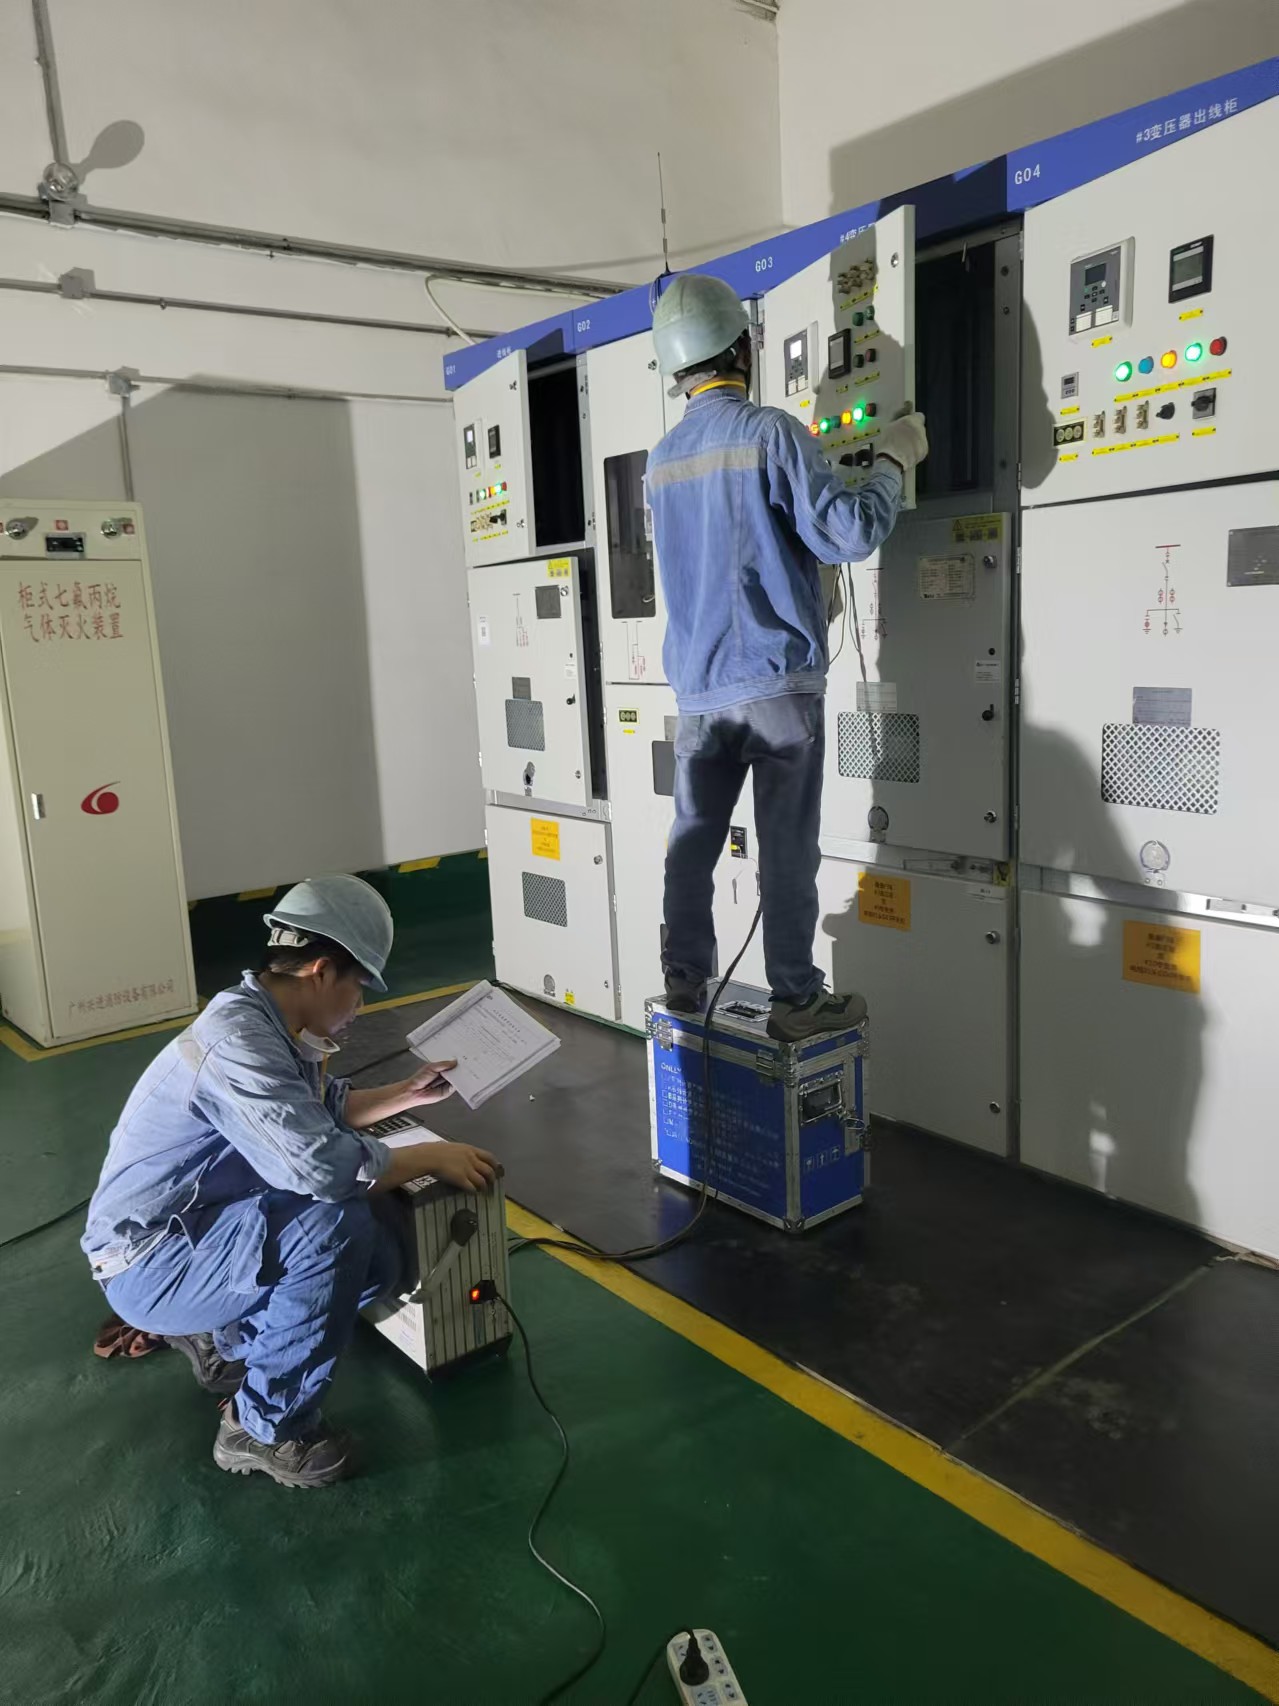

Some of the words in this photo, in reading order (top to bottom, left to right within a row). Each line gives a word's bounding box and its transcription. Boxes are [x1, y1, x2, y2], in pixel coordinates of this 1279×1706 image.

[1136, 98, 1238, 143] #3变压器出线柜
[1014, 163, 1041, 185] G04
[755, 256, 774, 273] G03
[577, 319, 591, 333] G02
[23, 611, 124, 643] 气体灭火装置
